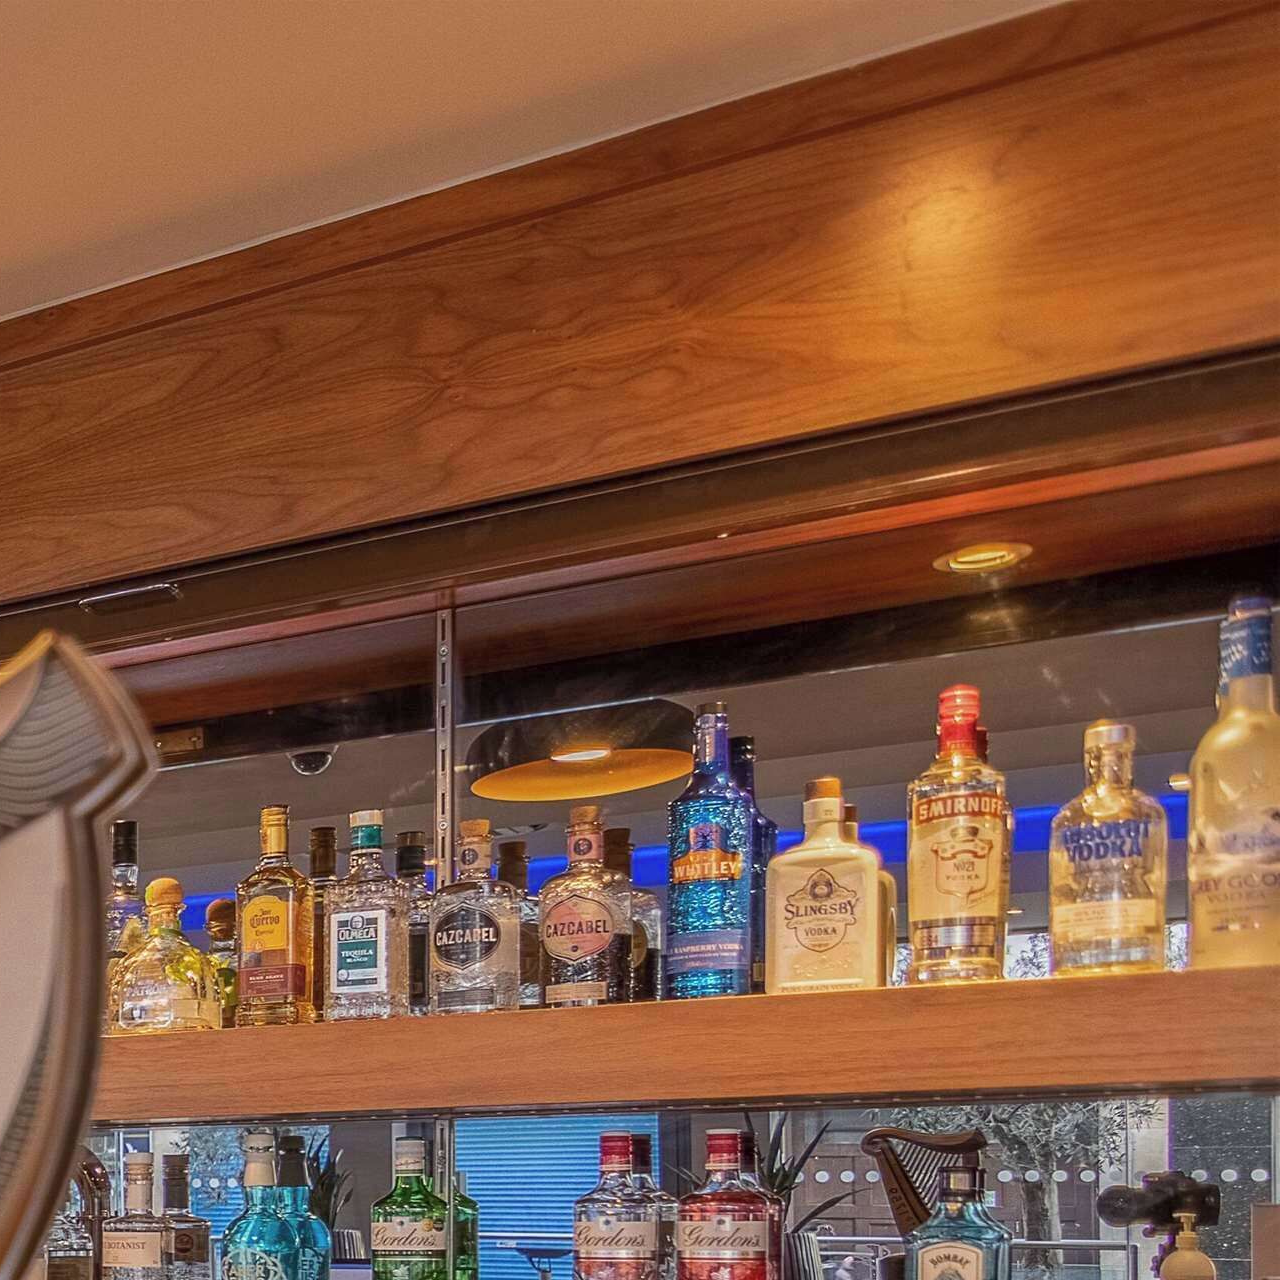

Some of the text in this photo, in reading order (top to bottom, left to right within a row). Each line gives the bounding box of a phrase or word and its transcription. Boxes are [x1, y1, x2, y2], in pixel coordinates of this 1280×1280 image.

[918, 797, 1004, 821] SMIRNOFF
[1067, 838, 1143, 862] VODKA
[674, 861, 738, 879] WHITLEY
[784, 897, 860, 921] SLINGSBY
[250, 914, 280, 928] Cuervo
[546, 920, 610, 939] CAZCABEL
[338, 928, 376, 940] OLMECA
[435, 928, 498, 945] CAZCABEL
[804, 926, 838, 937] VODKA
[341, 949, 373, 957] TEQUILA
[374, 1226, 437, 1247] Gordon's
[575, 1225, 646, 1248] Gordon's
[683, 1224, 761, 1248] Gordon's
[929, 1253, 972, 1269] BOMBAY
